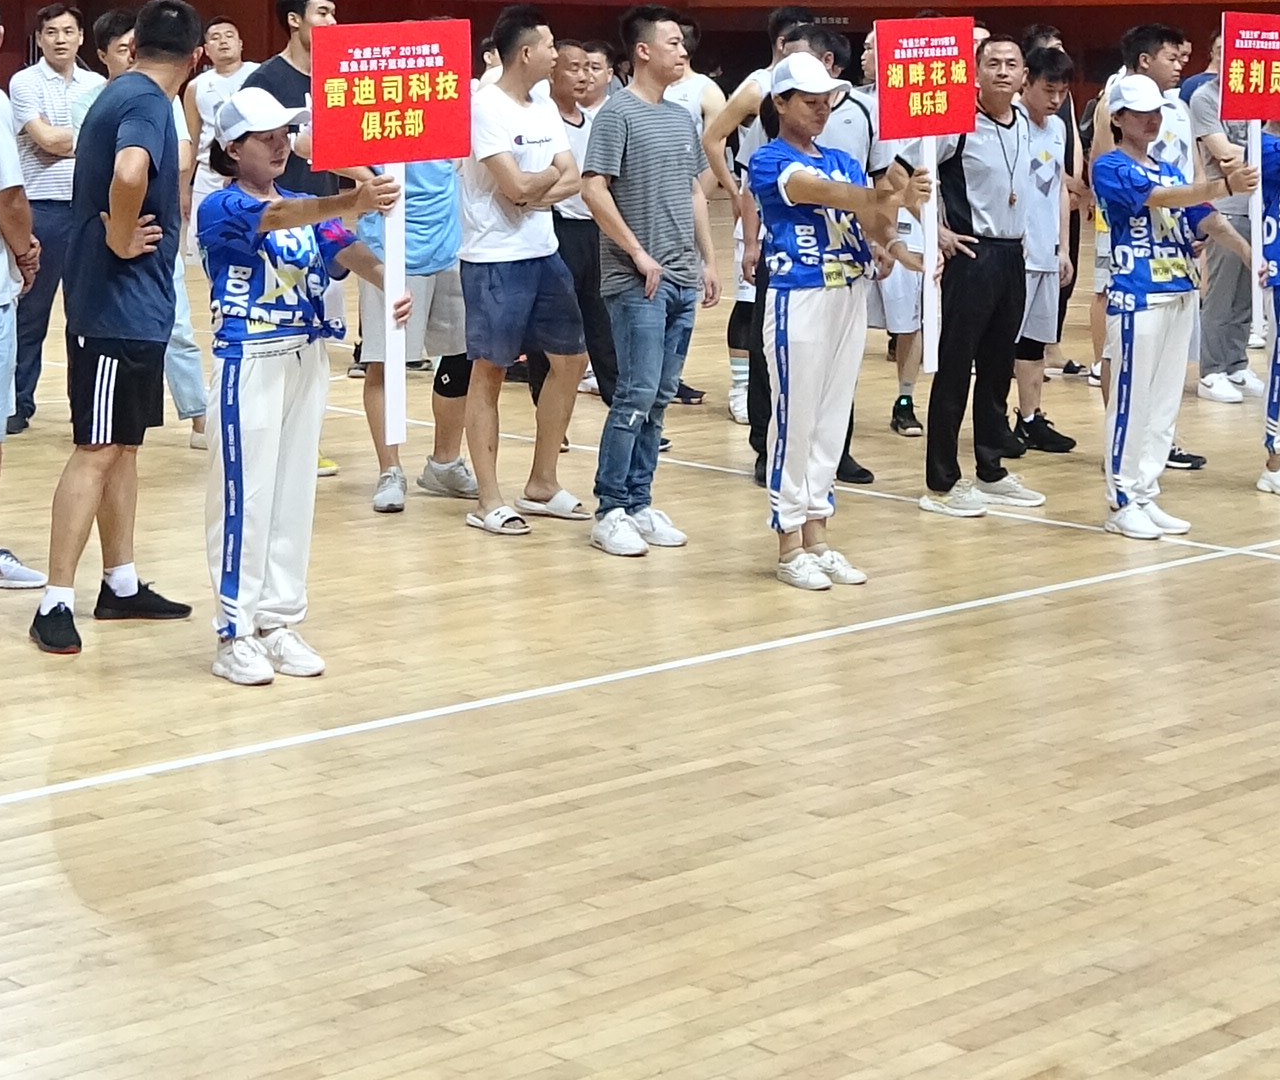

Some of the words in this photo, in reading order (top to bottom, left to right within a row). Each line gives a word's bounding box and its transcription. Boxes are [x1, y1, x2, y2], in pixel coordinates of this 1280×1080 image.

[324, 71, 459, 109] 雷迪司科技
[887, 59, 967, 88] 湖畔花城
[909, 90, 948, 117] 俱乐部
[361, 109, 425, 141] 俱乐部
[794, 224, 820, 266] BOYS
[222, 264, 252, 317] BOYS
